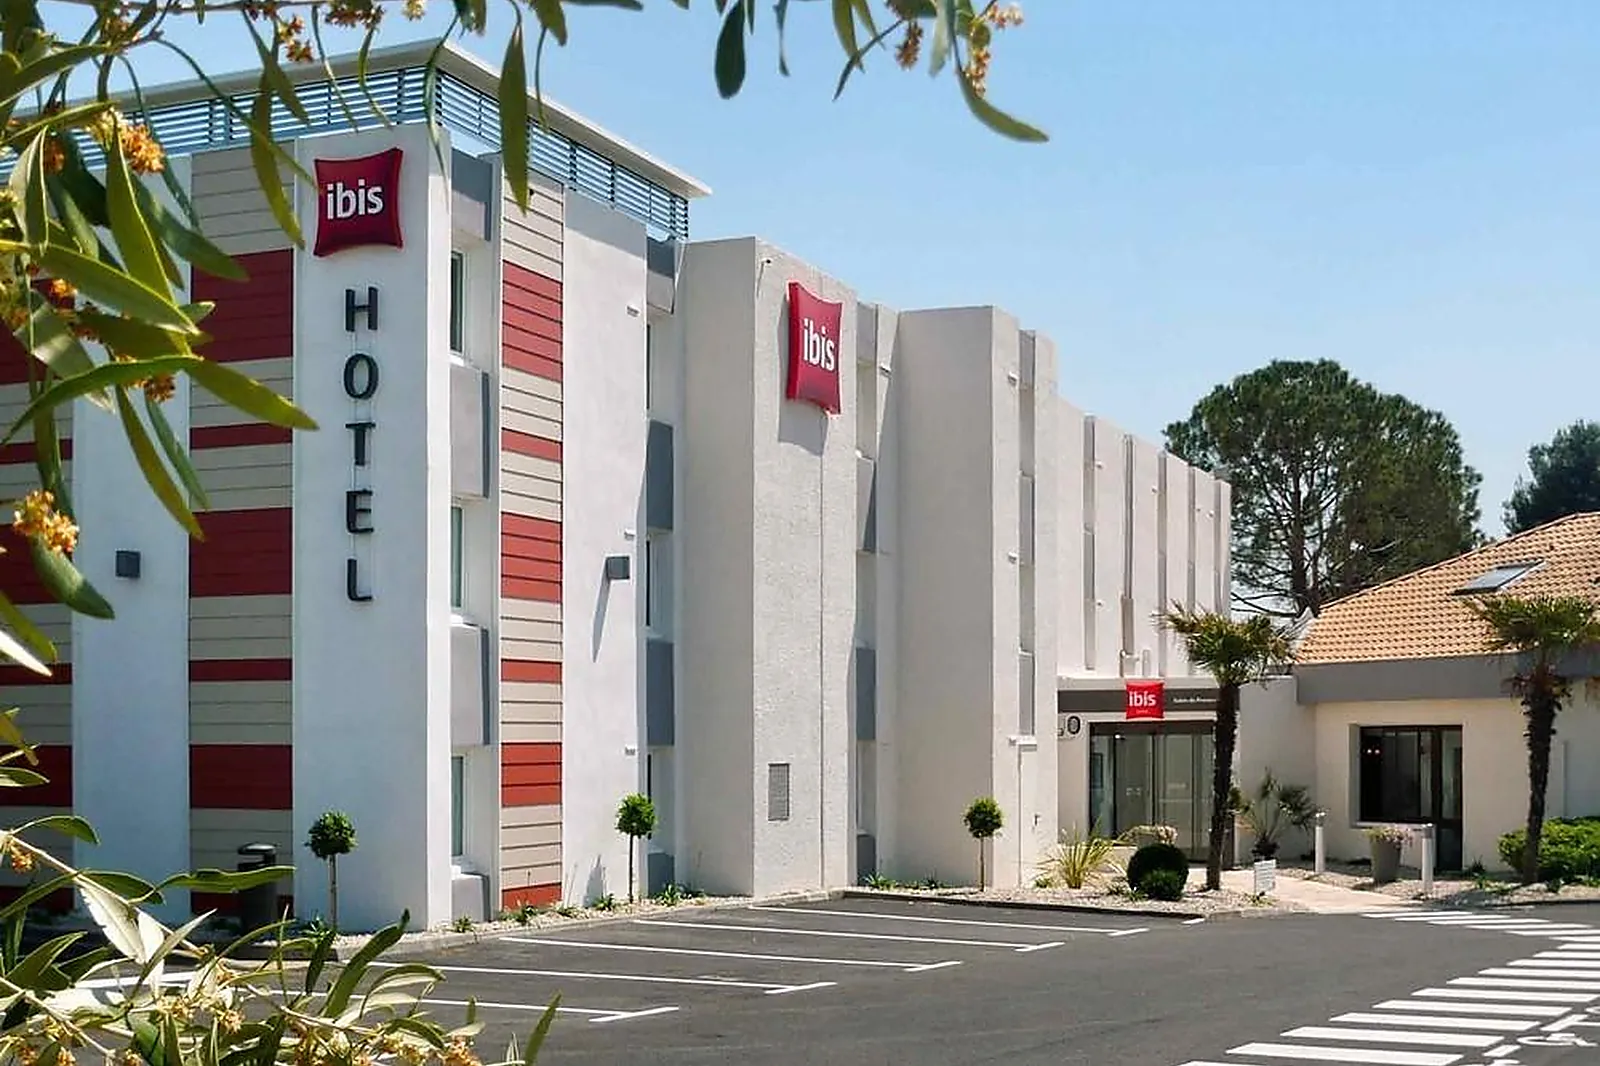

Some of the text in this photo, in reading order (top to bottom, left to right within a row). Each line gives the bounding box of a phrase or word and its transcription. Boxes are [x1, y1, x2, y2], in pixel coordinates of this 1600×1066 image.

[326, 178, 384, 220] ibis
[803, 317, 835, 372] ibis
[343, 286, 380, 603] HOTEL
[1128, 690, 1157, 707] ibis
